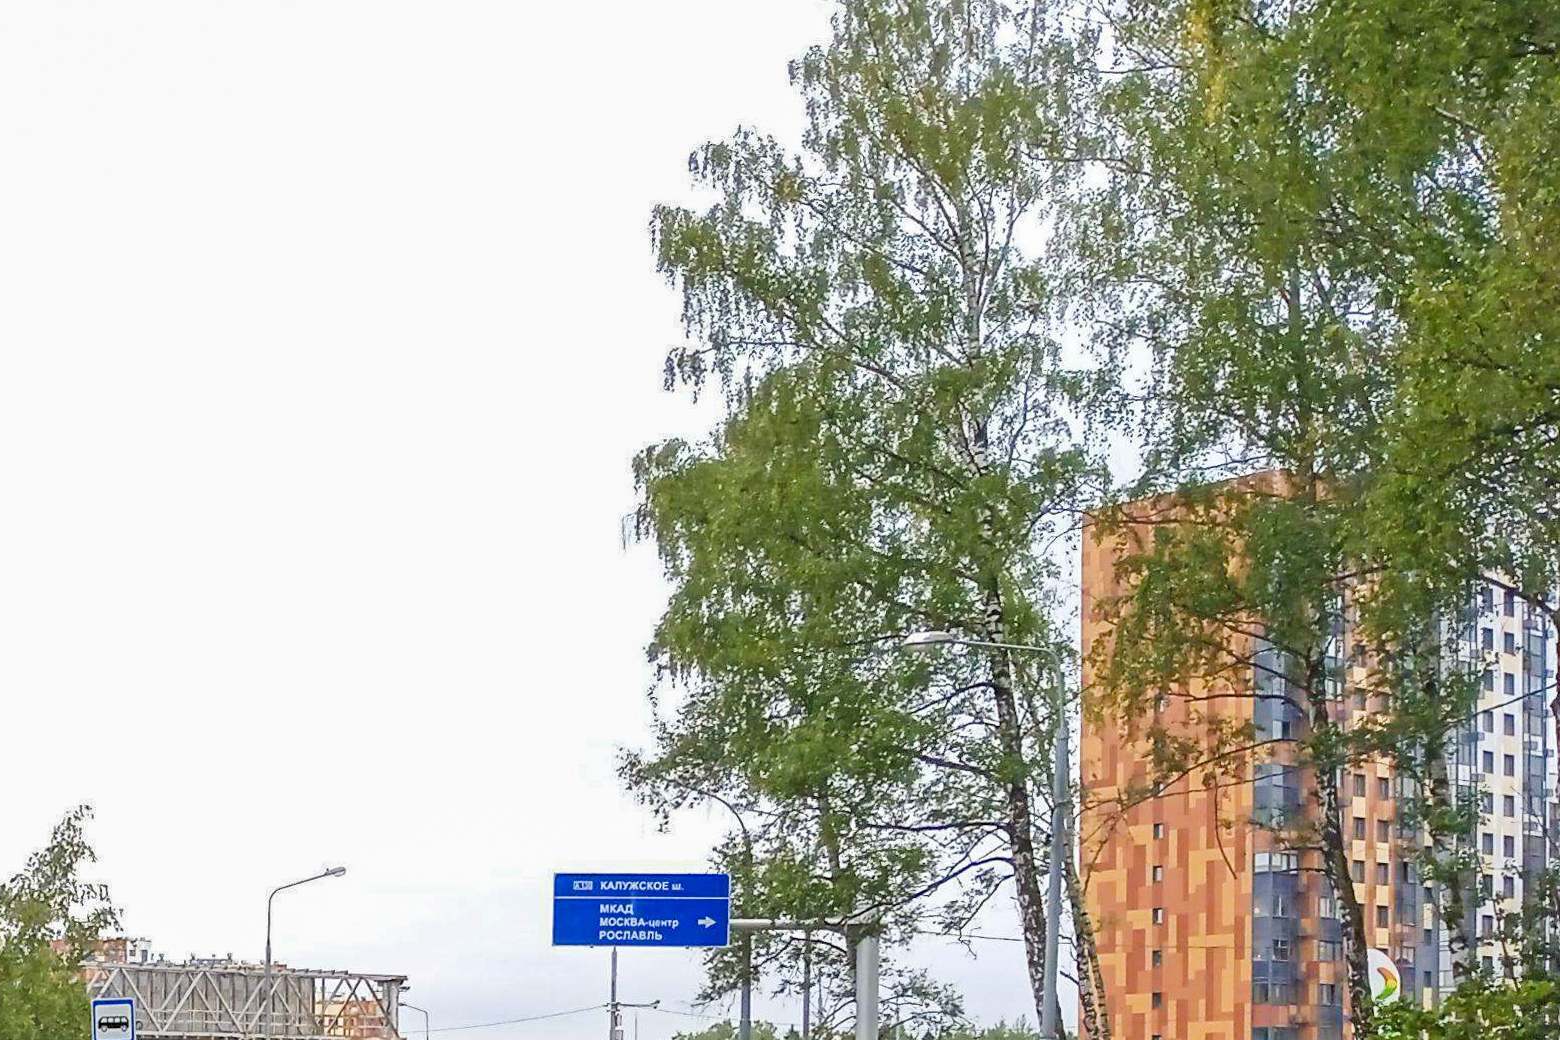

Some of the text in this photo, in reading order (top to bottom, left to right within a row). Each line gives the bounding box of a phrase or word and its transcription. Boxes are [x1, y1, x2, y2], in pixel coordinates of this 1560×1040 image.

[600, 881, 669, 891] КАЛУЖСКОЕ
[671, 882, 684, 891] ш.
[600, 903, 634, 915] МКАД
[600, 917, 679, 929] МОСКВА-центр
[599, 930, 663, 941] РОСЛАВЛЬ
